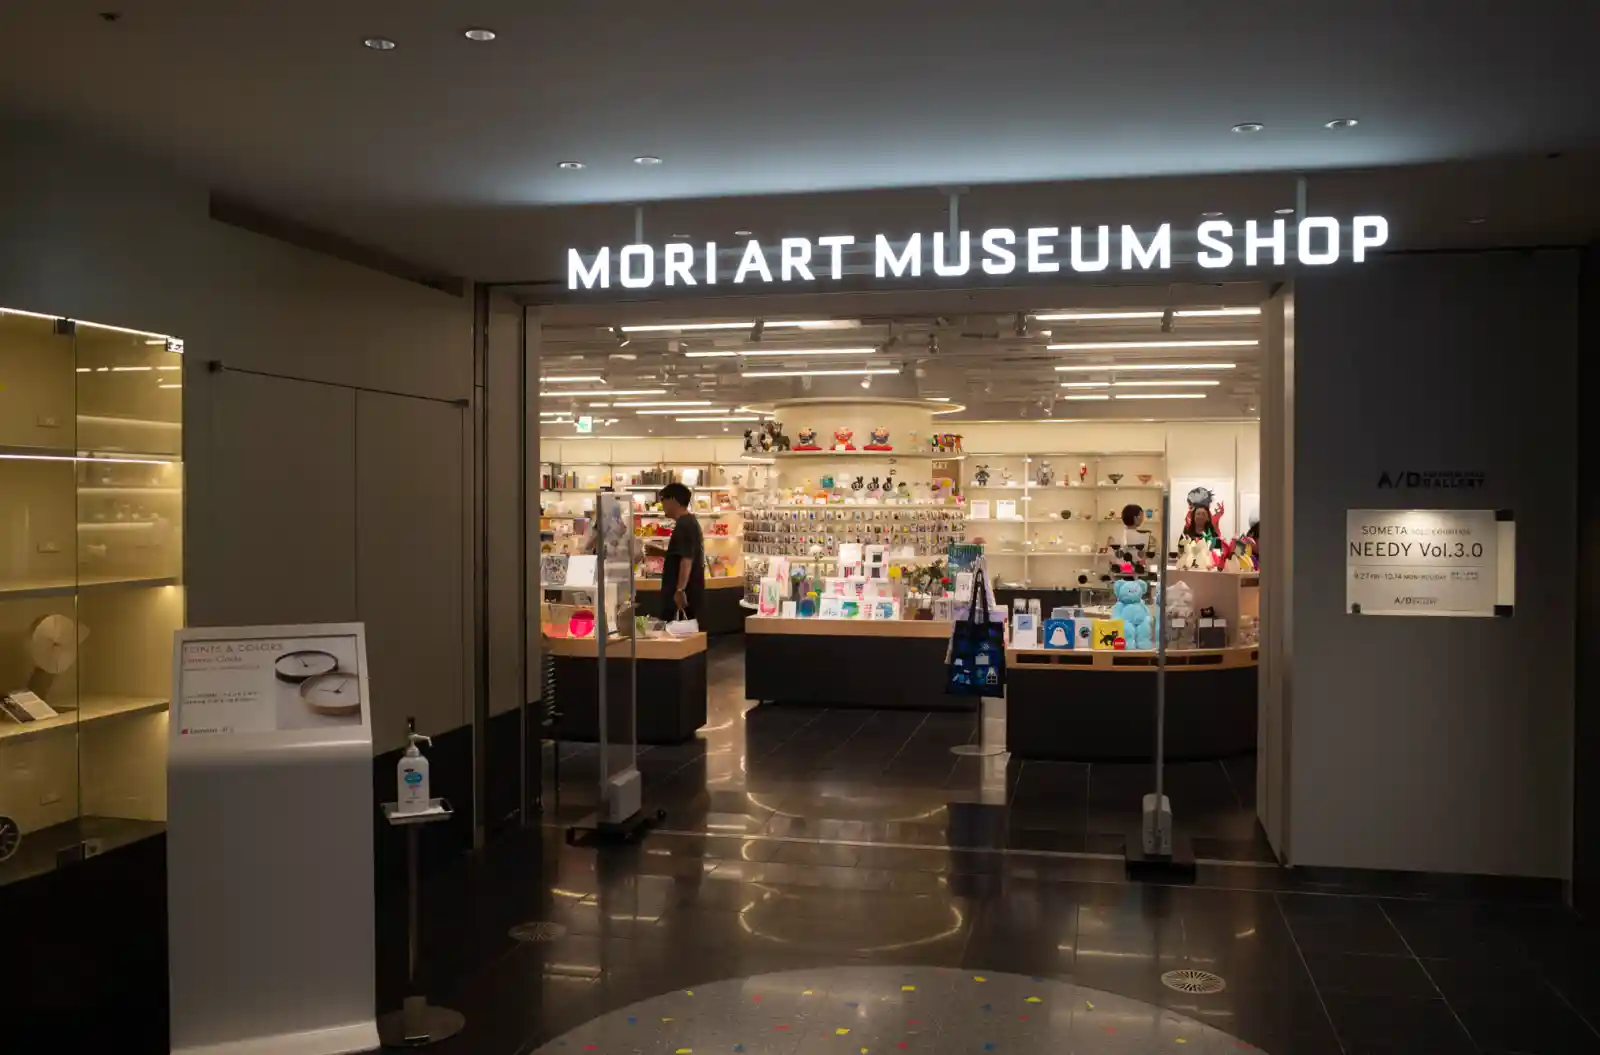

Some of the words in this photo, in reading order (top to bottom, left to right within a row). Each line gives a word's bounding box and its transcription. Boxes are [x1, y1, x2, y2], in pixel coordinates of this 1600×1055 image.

[567, 242, 717, 290] MORI
[733, 235, 856, 284] ART
[874, 223, 1172, 278] MUSEUM
[1196, 214, 1390, 269] SHOP
[1361, 525, 1407, 536] SOMETA
[1349, 541, 1412, 557] NEEDY
[1419, 542, 1483, 558] Vol.3.0
